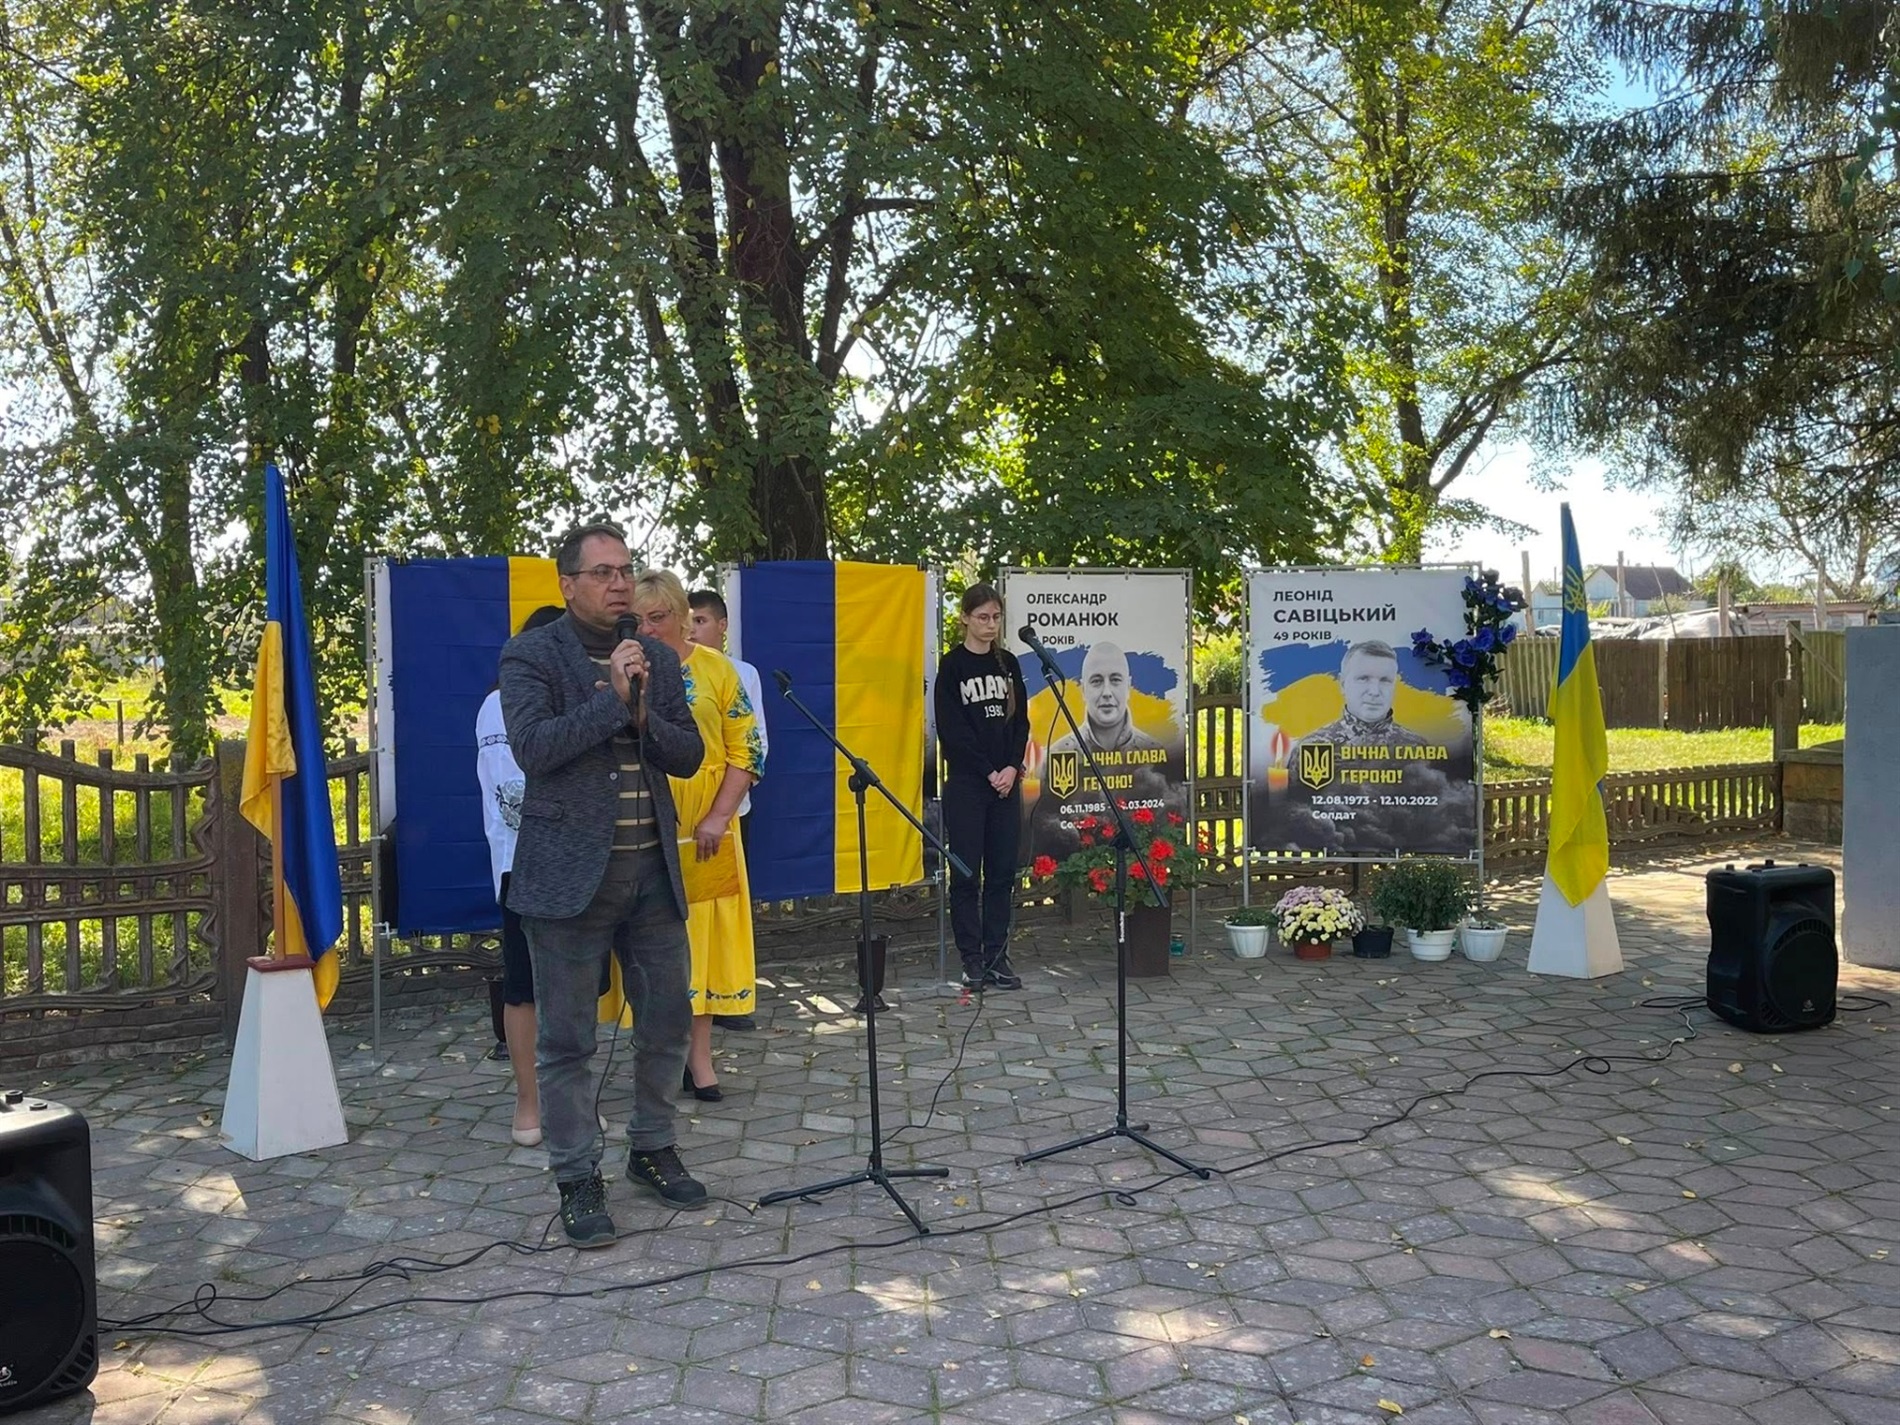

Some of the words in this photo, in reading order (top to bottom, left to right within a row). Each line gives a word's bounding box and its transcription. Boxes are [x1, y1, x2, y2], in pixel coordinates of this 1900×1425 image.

[1026, 593, 1107, 606] ОЛЕКСАНДР
[1273, 590, 1333, 602] ЛЕОНІД
[1027, 612, 1118, 627] РОМАНЮК
[1273, 603, 1396, 624] САВІЦЬКИЙ
[1042, 635, 1075, 645] РОКІВ
[1273, 632, 1289, 641] 49
[1292, 631, 1332, 640] РОКІВ
[960, 674, 1014, 705] MIAM
[1126, 749, 1168, 765] СЛАВА
[1341, 746, 1391, 760] ВІЧНА
[1395, 745, 1448, 760] СЛАВА
[1341, 769, 1403, 784] ГЕРОЮ!
[1060, 803, 1106, 814] 06.11.1985
[1116, 799, 1165, 810] .03.2024
[1312, 796, 1370, 805] 12.08.1973
[1380, 796, 1438, 805] 12.10.2022
[1312, 810, 1356, 820] Солдат
